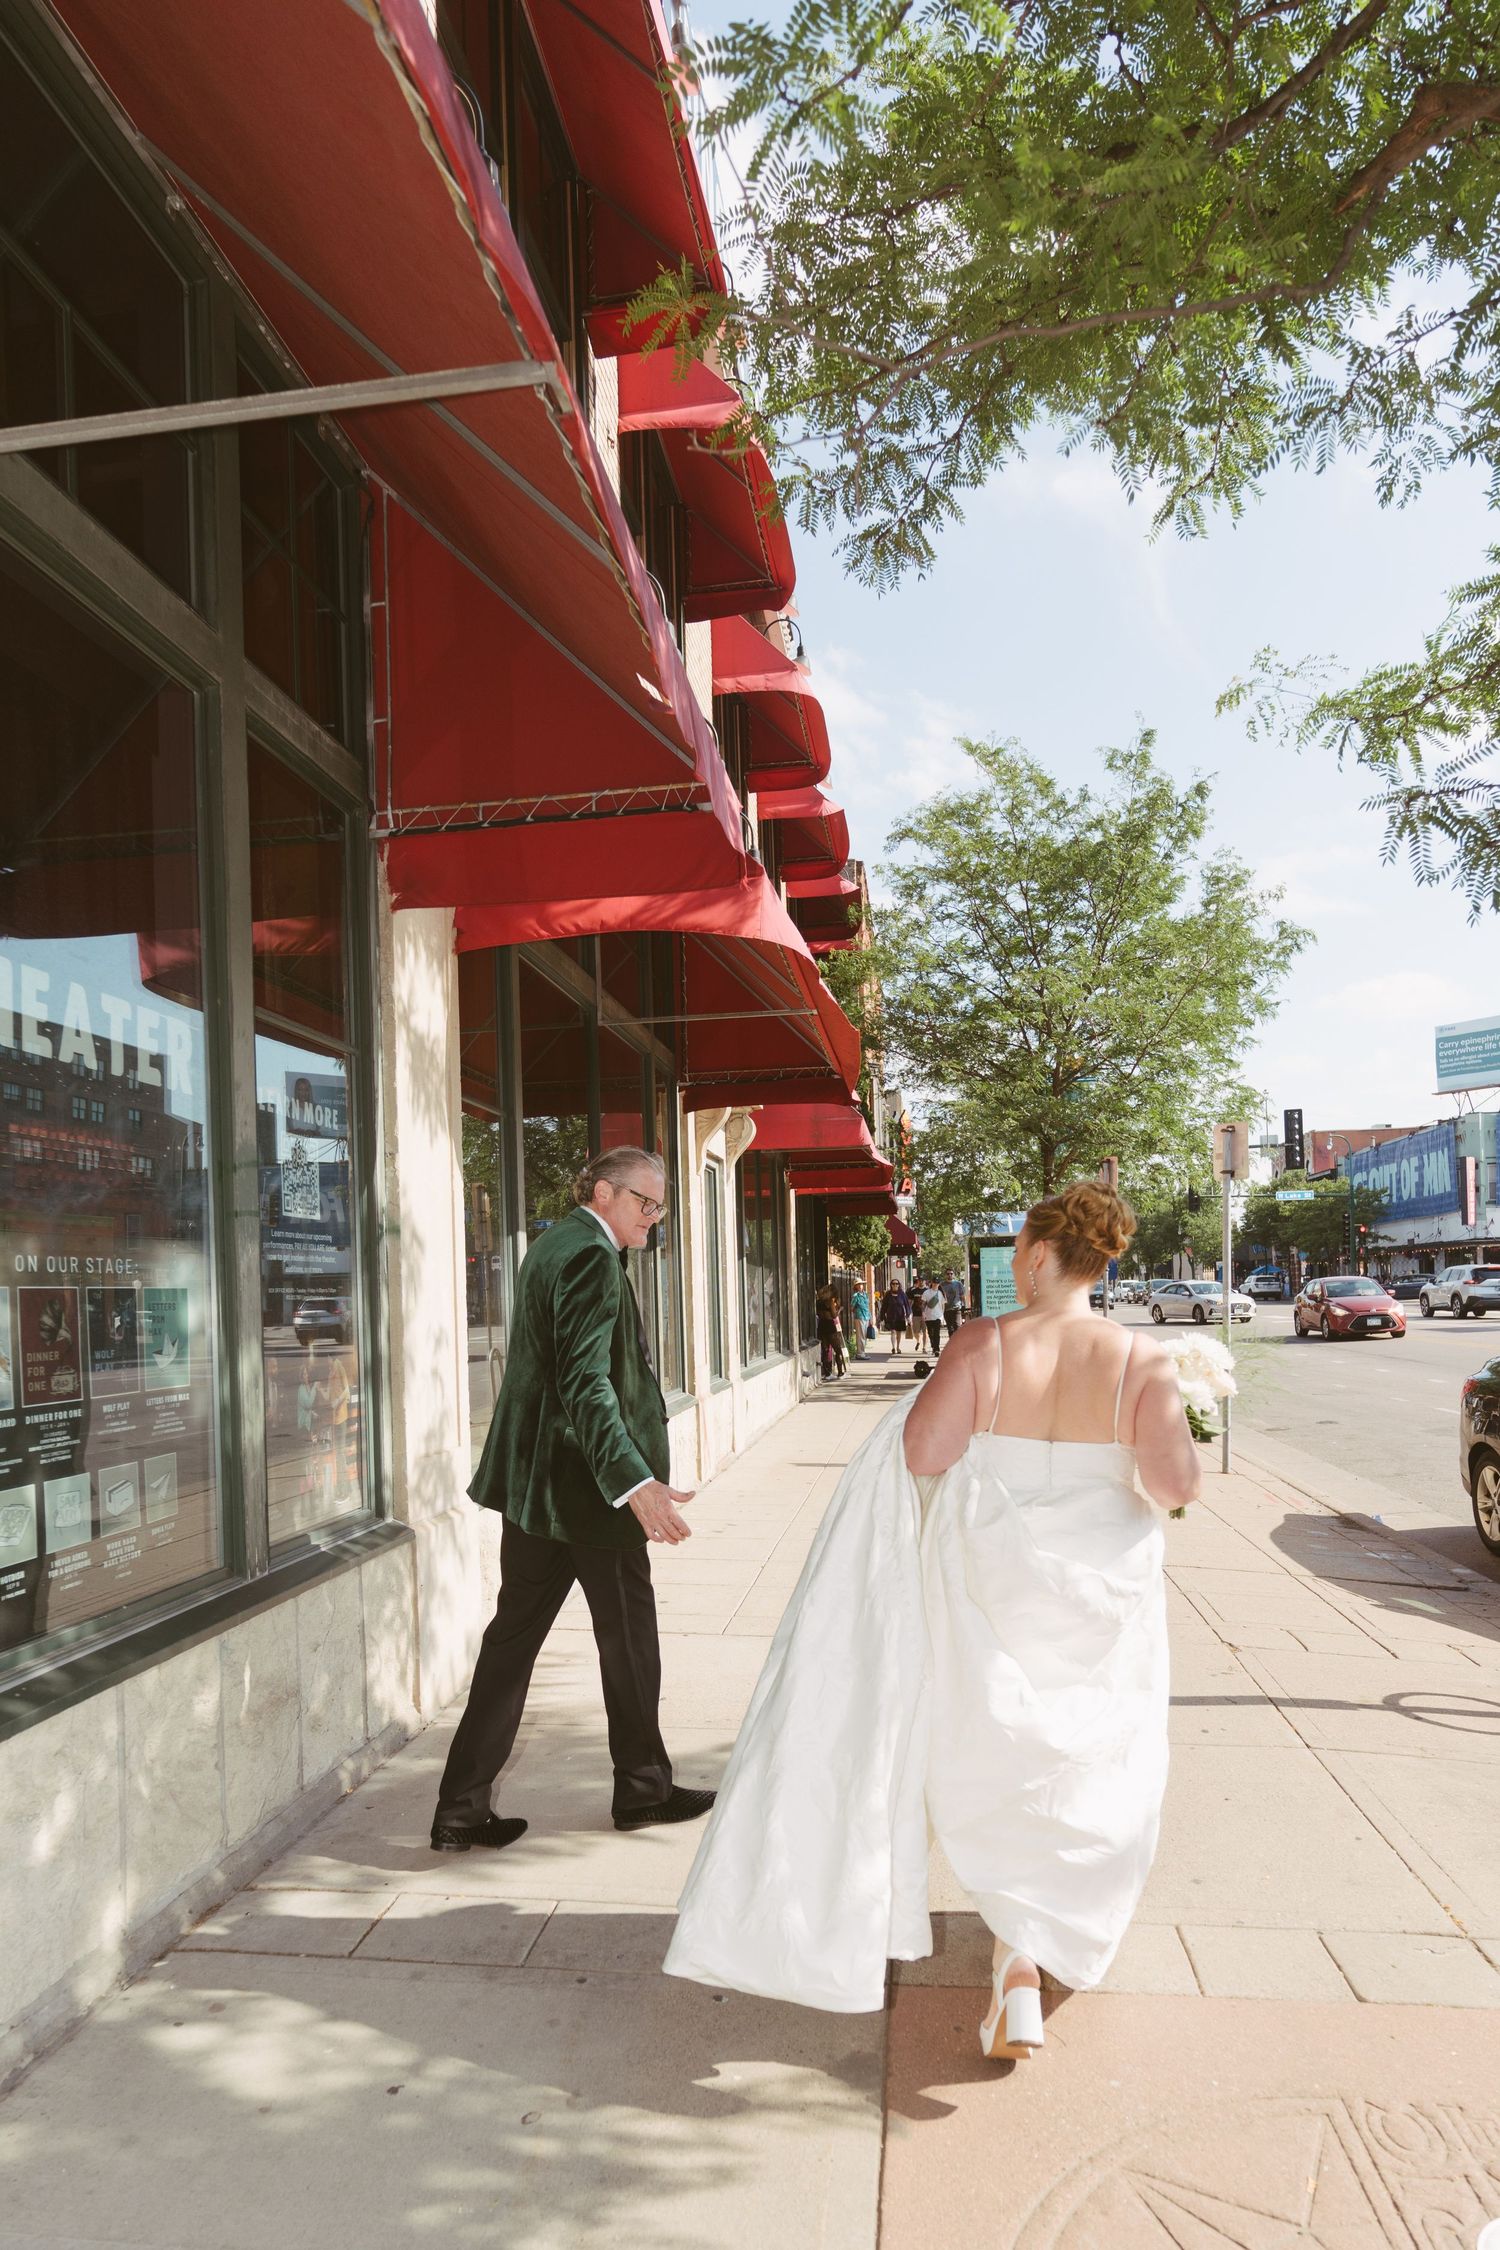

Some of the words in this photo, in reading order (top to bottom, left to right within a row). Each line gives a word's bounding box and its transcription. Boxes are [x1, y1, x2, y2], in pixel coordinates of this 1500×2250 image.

[1439, 1041, 1459, 1049] Carry
[1439, 1045, 1483, 1057] everywhere
[1485, 1042, 1497, 1050] life
[303, 1101, 338, 1131] MORE
[1400, 1156, 1419, 1200] OF
[15, 1254, 38, 1273] ON
[46, 1256, 79, 1273] OUR
[86, 1257, 139, 1274] STAGE:
[149, 1302, 177, 1311] LETTERS
[26, 1351, 60, 1362] DINNER
[94, 1349, 116, 1359] WOLF
[27, 1366, 46, 1377] FOR
[28, 1381, 47, 1392] ONE
[117, 1401, 130, 1411] PLAY
[25, 1412, 53, 1424] DINNER
[54, 1410, 68, 1420] FOR
[68, 1408, 82, 1418] ONE
